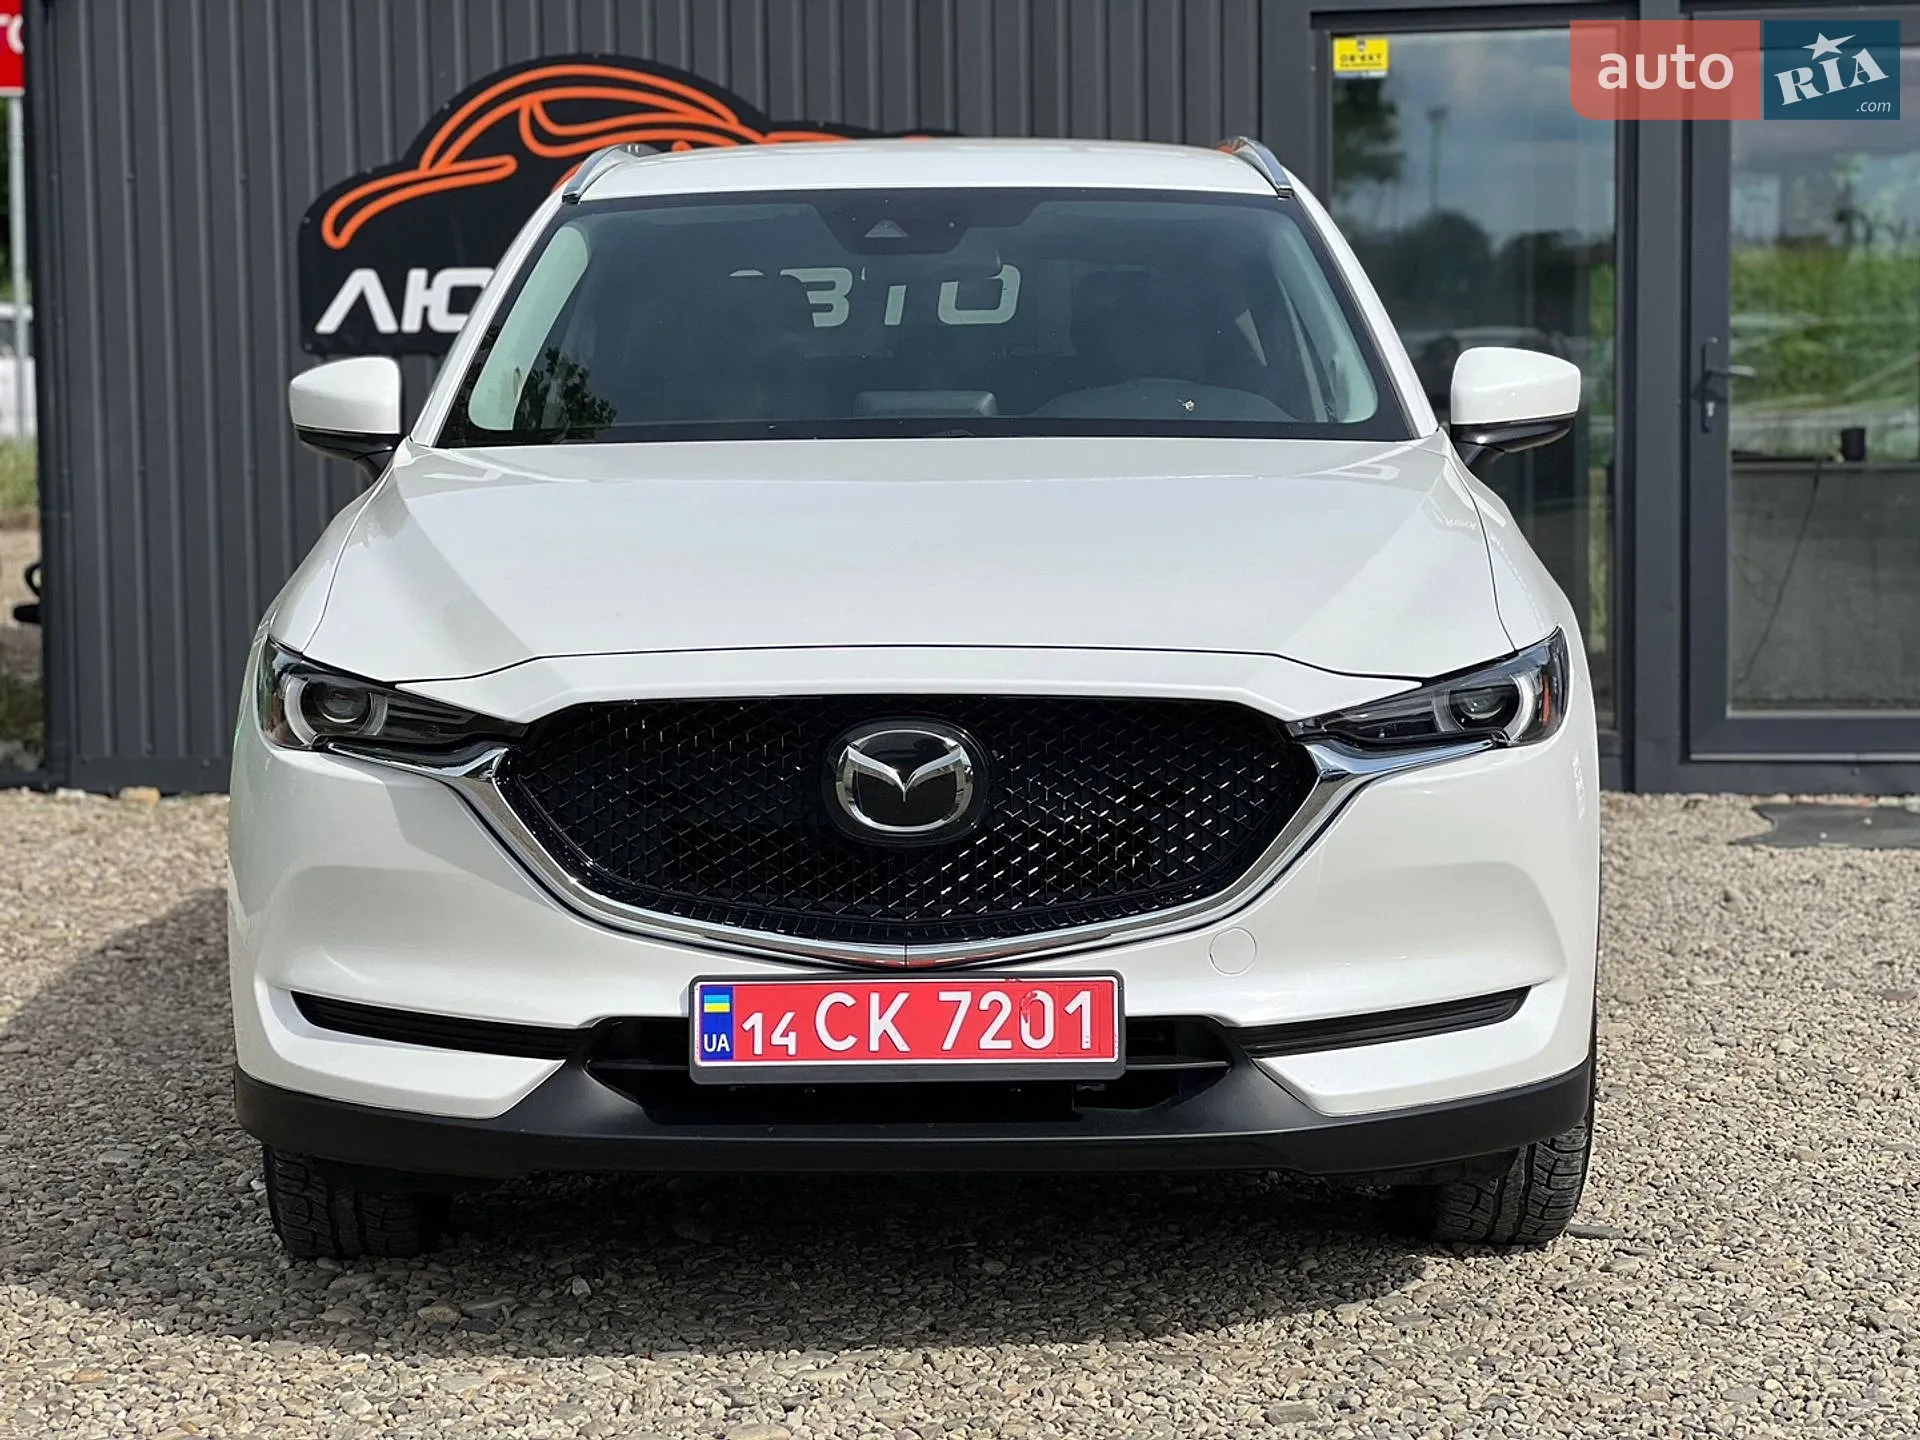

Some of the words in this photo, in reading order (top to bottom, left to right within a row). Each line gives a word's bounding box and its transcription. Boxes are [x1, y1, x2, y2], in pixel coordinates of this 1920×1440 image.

[703, 1033, 731, 1053] UA
[741, 1012, 798, 1056] 14
[814, 991, 911, 1053] CK
[938, 990, 1092, 1051] 7201
